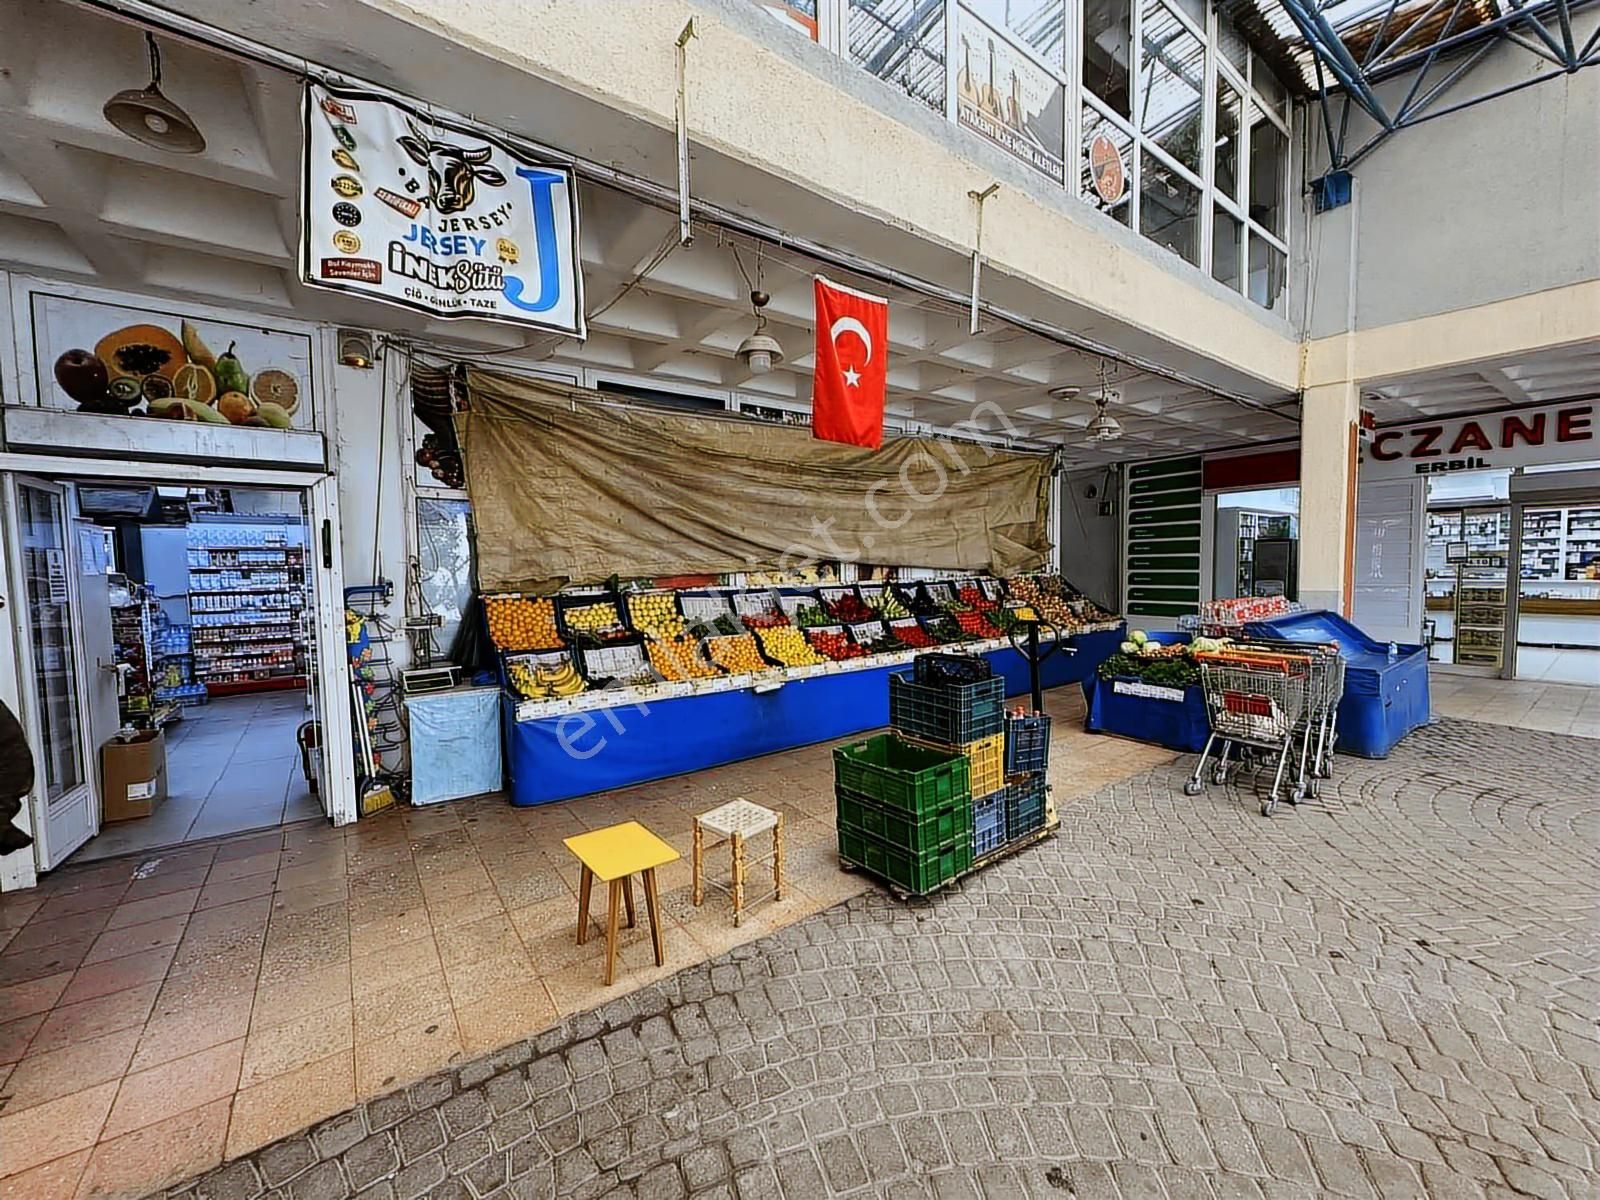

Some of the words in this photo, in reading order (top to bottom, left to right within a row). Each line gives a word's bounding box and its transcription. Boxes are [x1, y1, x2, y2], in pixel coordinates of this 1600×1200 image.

[402, 224, 487, 256] JERSEY
[502, 166, 564, 312] J
[469, 298, 497, 309] TAZE
[1358, 406, 1593, 464] CZANE
[1415, 456, 1492, 474] ERBİL
